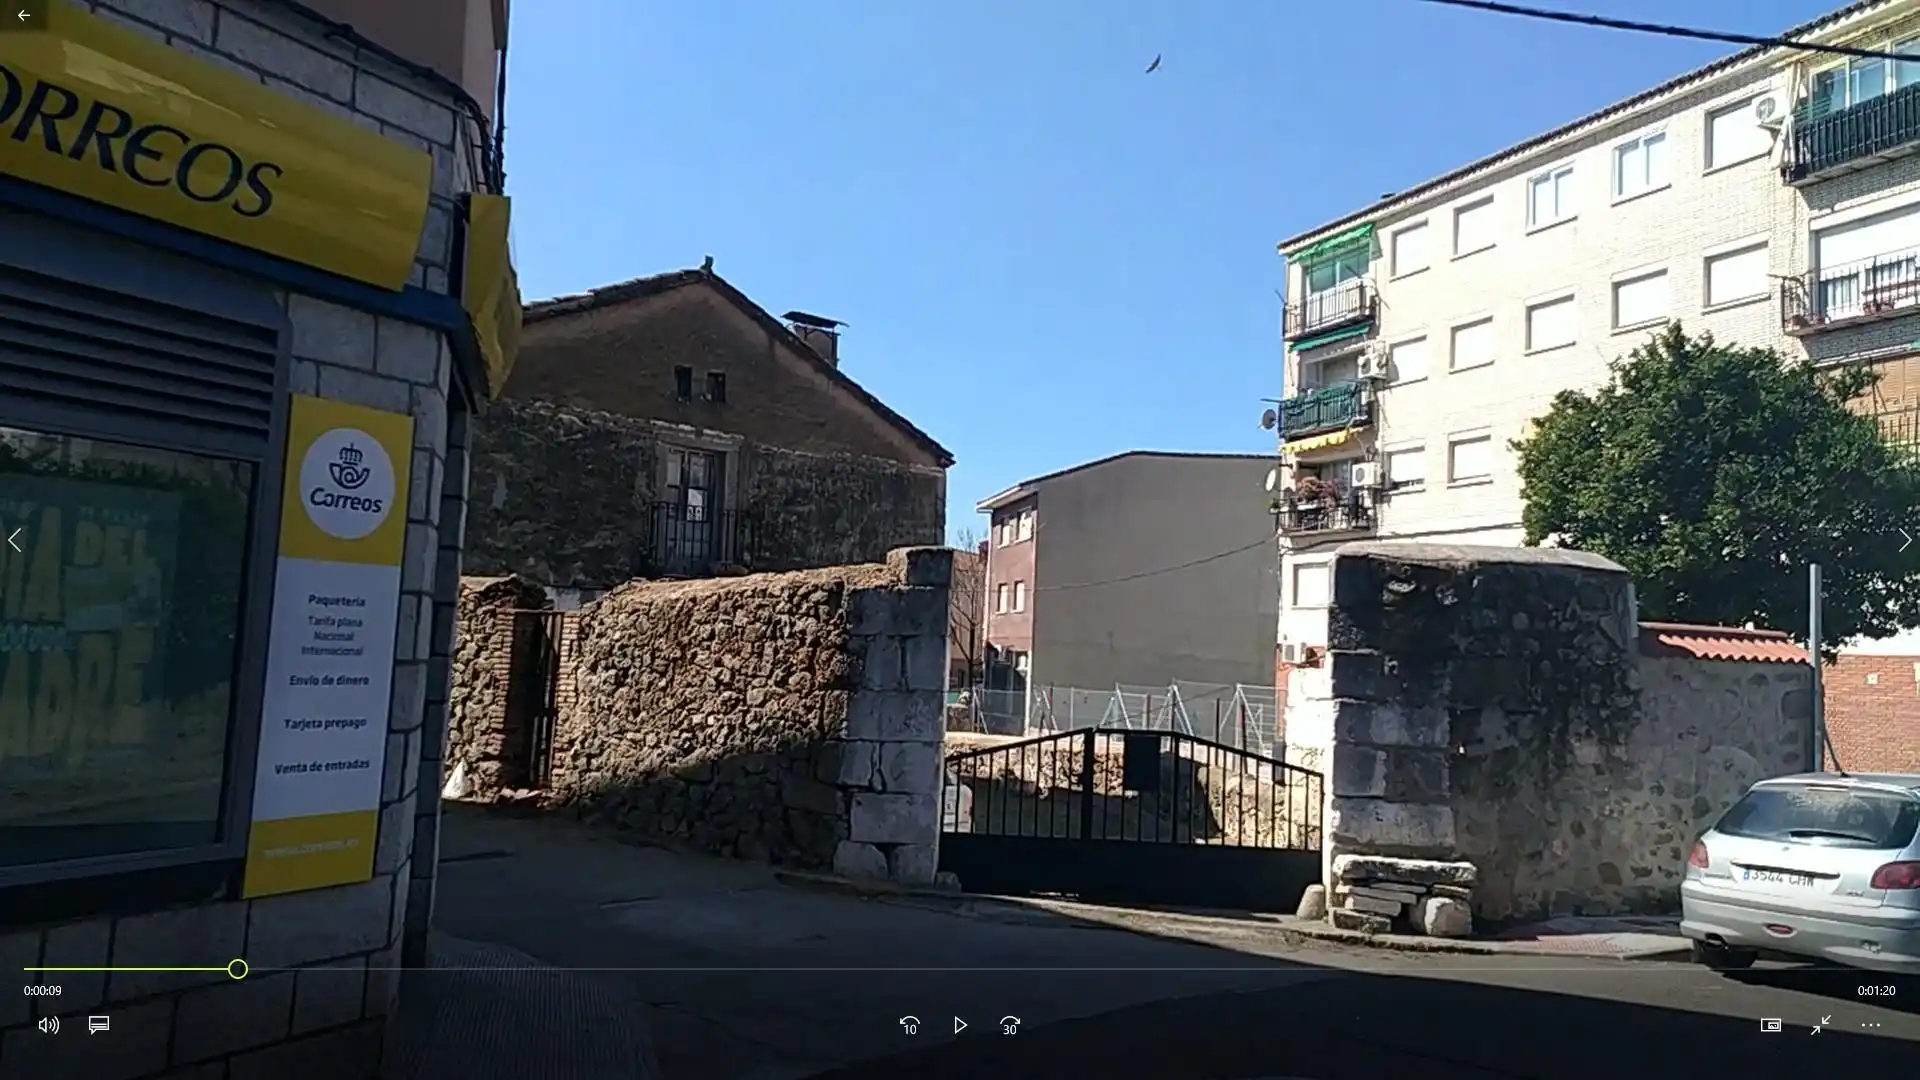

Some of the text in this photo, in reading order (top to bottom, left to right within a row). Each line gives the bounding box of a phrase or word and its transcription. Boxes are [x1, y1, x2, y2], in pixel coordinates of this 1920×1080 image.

[310, 487, 383, 513] Correos
[308, 616, 363, 629] Tarifa plana
[321, 675, 334, 686] de
[336, 675, 370, 686] dinero
[284, 718, 367, 731] Tarjeta prepago
[274, 759, 370, 775] Venta de entradas
